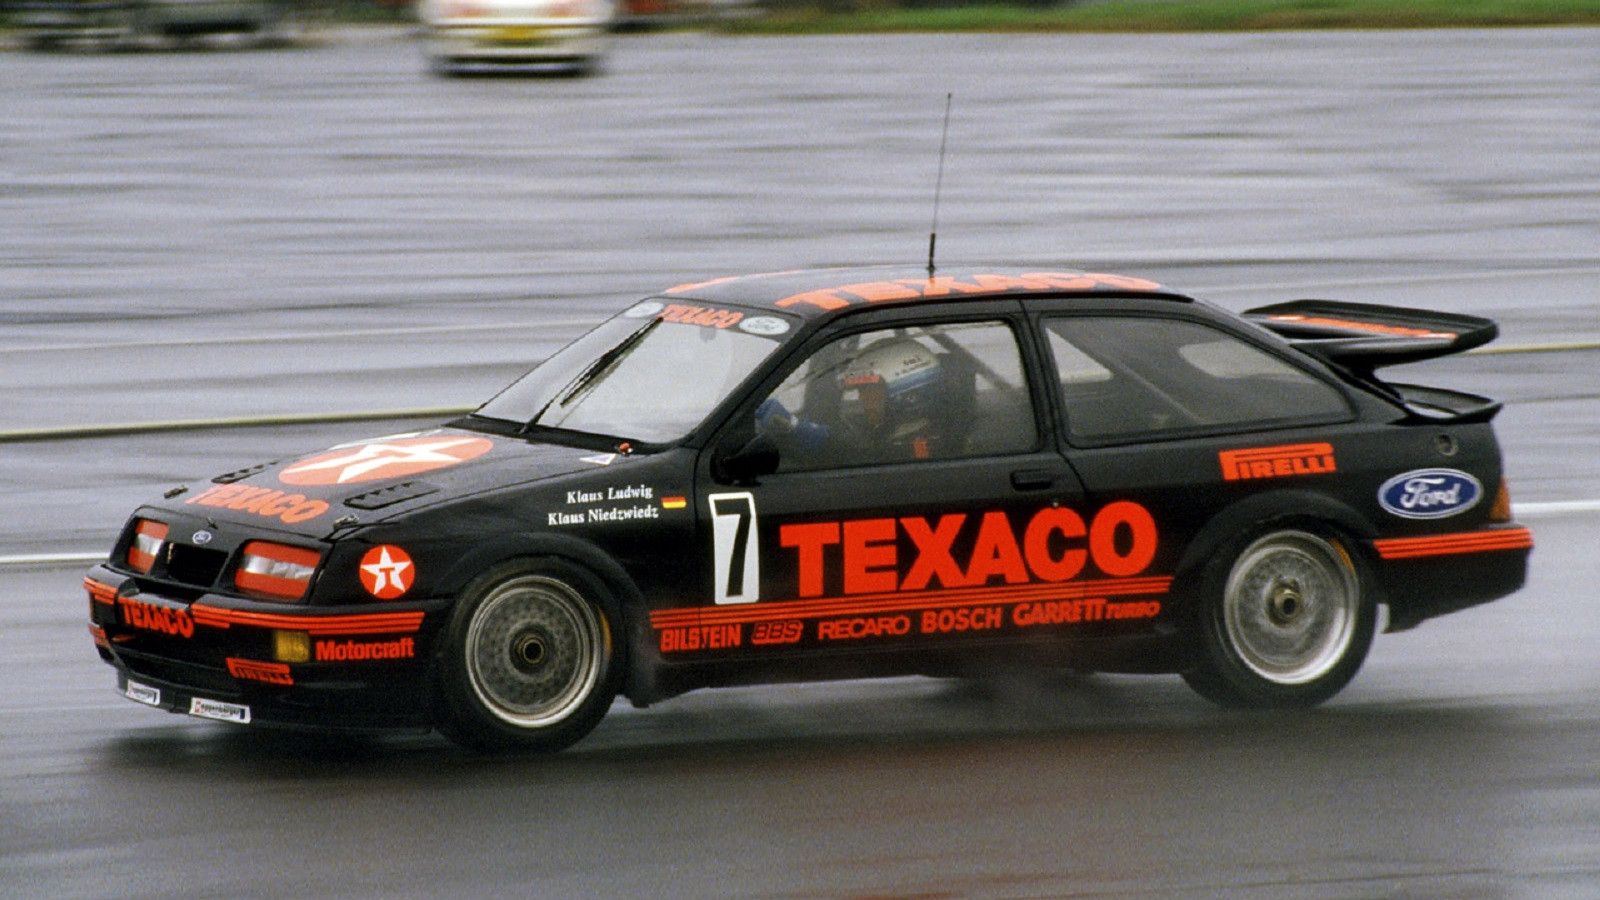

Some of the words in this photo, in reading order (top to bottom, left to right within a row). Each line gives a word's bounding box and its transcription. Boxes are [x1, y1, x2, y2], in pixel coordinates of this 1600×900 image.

[774, 272, 1161, 310] TEXACO
[658, 304, 744, 328] TEXACO
[1219, 442, 1336, 481] PIRELLI
[185, 484, 330, 523] TEXACO
[566, 490, 604, 505] Klaus
[608, 484, 653, 500] Ludwig
[1400, 477, 1462, 508] Ford
[548, 511, 585, 526] Klaus
[588, 504, 659, 523] Niedzwiedz
[712, 496, 752, 598] 7
[780, 501, 1157, 597] TEXACO
[122, 601, 194, 639] TEXACO
[660, 623, 742, 653] BILSTEIN
[752, 621, 804, 645] BBS
[818, 615, 911, 640] RECARO
[920, 607, 1002, 633] BOSCH
[1012, 598, 1107, 626] GARRETT
[1106, 601, 1161, 620] TURBO
[316, 637, 415, 660] Motorcraft
[226, 657, 293, 685] PIRELLI
